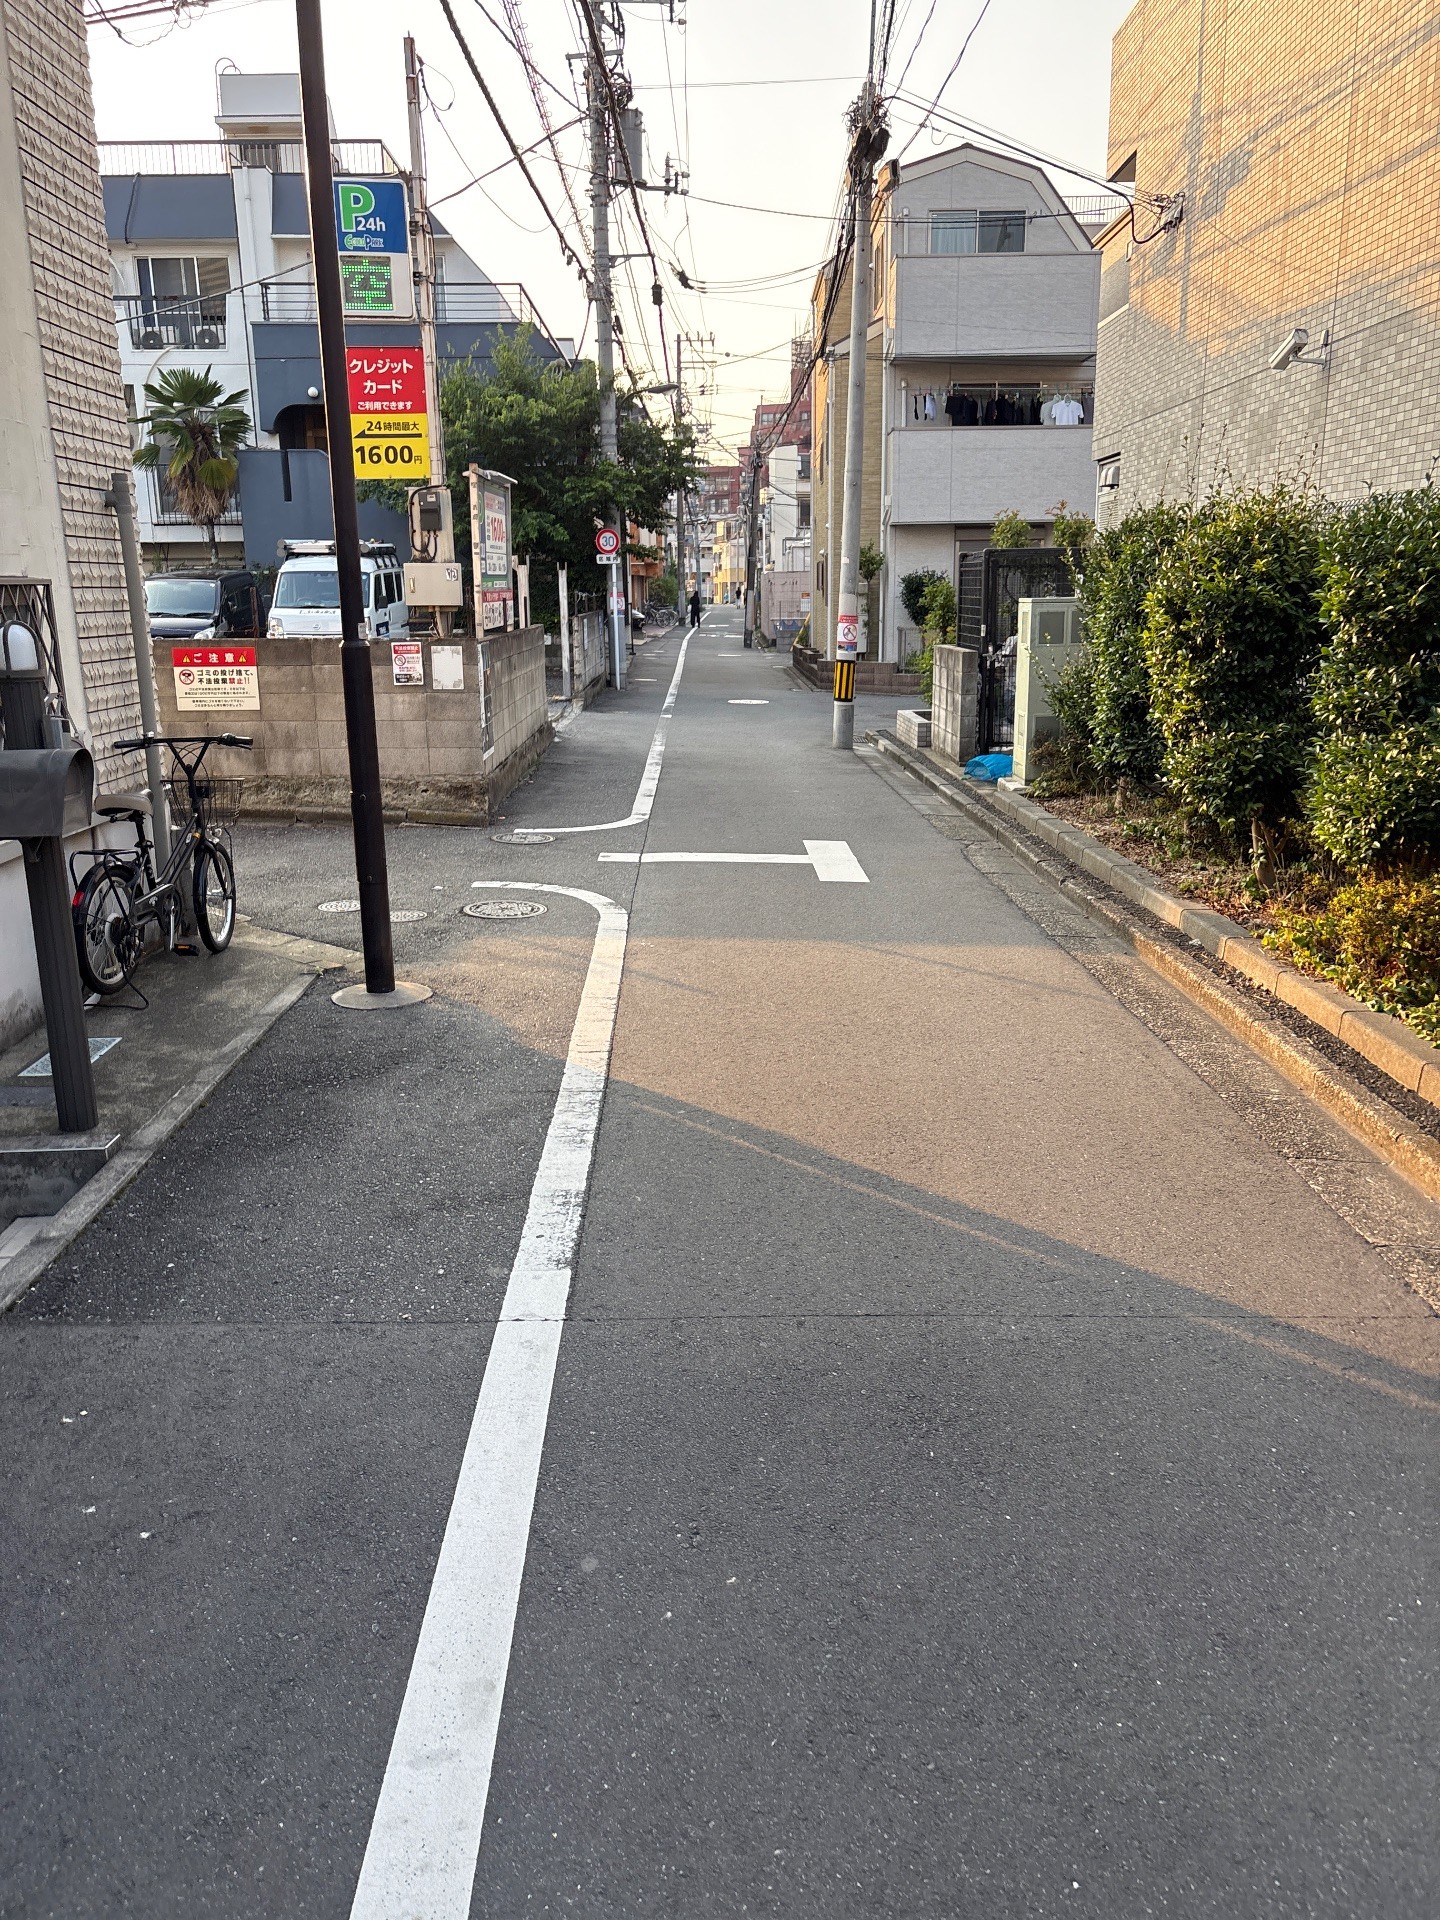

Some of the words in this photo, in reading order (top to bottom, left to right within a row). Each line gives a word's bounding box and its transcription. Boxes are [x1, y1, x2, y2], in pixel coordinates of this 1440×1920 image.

[338, 184, 375, 232] P
[356, 217, 386, 231] 24h
[342, 259, 393, 310] 空
[349, 359, 413, 374] クレジット
[363, 379, 402, 395] カード
[357, 401, 413, 411] ご利用できます
[366, 421, 420, 432] 24時間最大
[354, 445, 423, 465] 1600円
[601, 535, 615, 547] 30
[193, 652, 235, 663] ご注意
